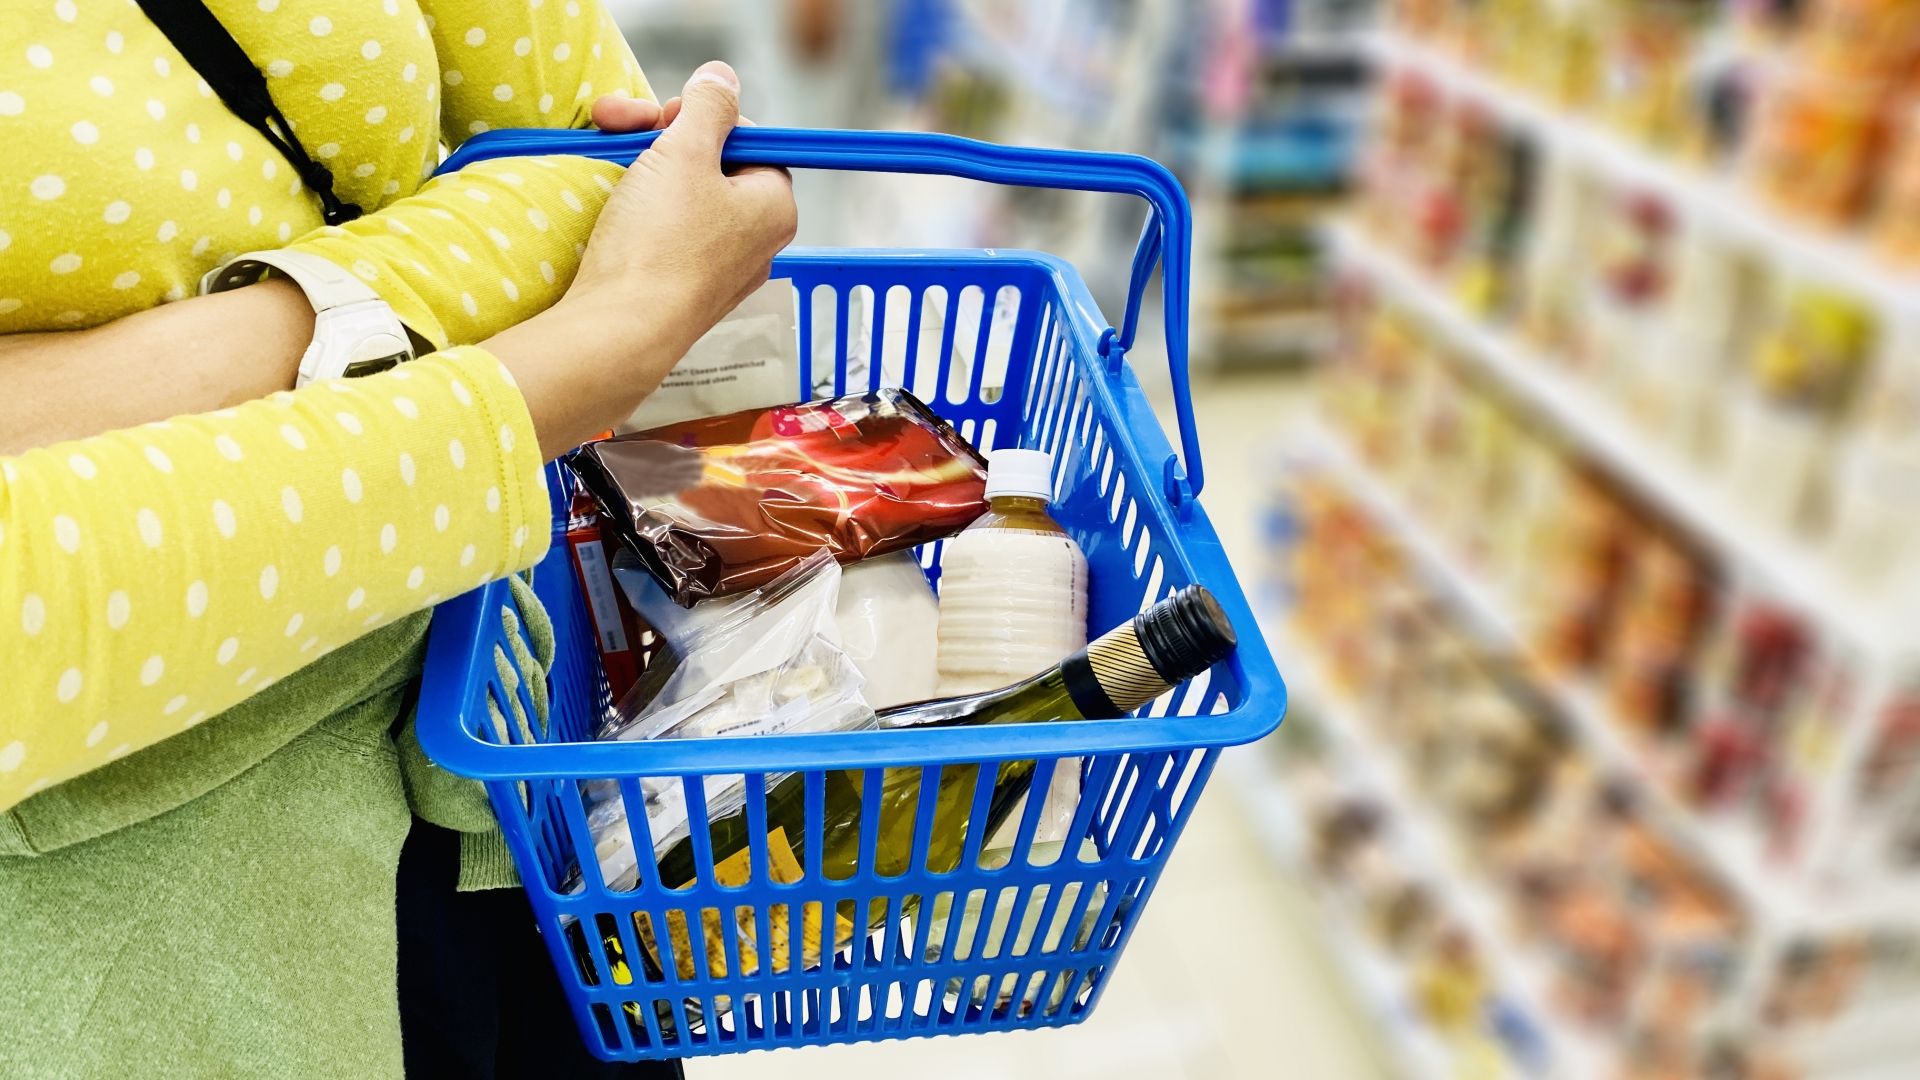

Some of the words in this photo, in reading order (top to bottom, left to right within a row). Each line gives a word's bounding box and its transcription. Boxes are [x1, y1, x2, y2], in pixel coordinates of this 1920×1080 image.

[690, 367, 718, 376] Cheese
[719, 360, 766, 372] sandwiched
[660, 379, 694, 389] between
[712, 375, 737, 384] sheets
